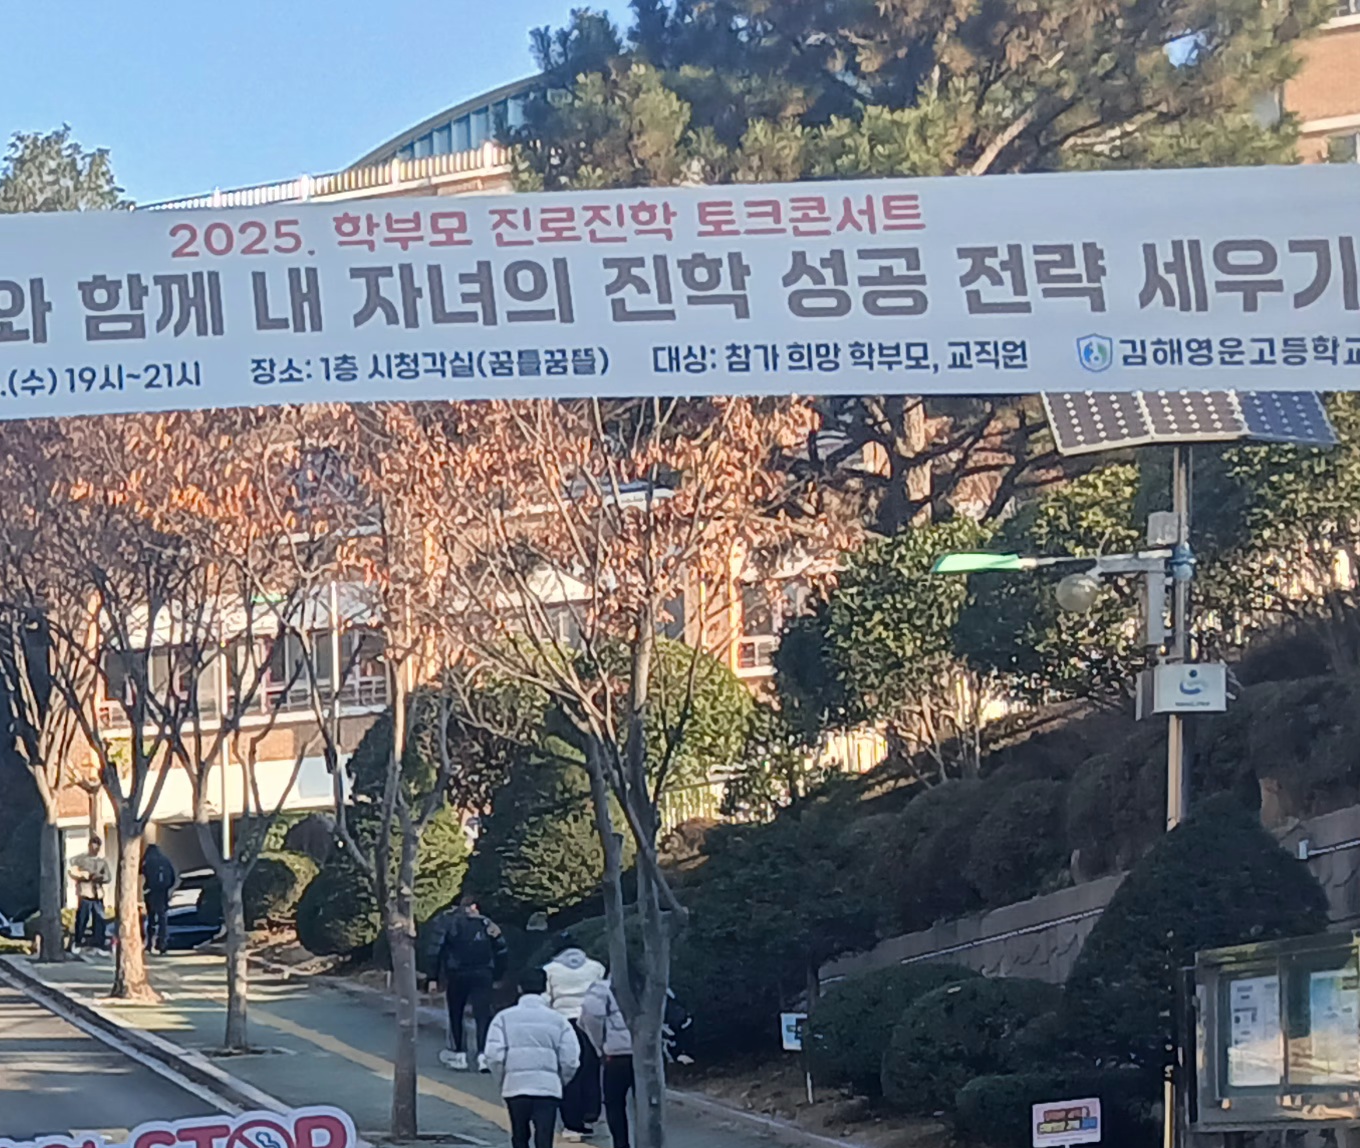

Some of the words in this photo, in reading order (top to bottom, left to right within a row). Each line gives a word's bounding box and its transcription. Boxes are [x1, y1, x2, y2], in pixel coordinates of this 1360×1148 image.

[169, 221, 316, 260] 2025.
[333, 207, 474, 254] 학부모
[488, 198, 677, 246] 진로진학
[695, 192, 927, 239] 토크콘서트
[77, 268, 223, 342] 함께
[251, 267, 325, 334] 내
[347, 256, 572, 330] 자녀의
[602, 250, 752, 322] 진학
[781, 245, 930, 319] 성공
[959, 241, 1107, 315] 전략
[1138, 236, 1360, 312] 세우기
[250, 355, 313, 385] 장소:
[320, 353, 360, 382] 1층
[653, 342, 718, 373] 대상:
[723, 340, 781, 373] 참가
[787, 340, 842, 372] 희망
[848, 339, 941, 374] 학부모,
[947, 337, 1028, 370] 교직원
